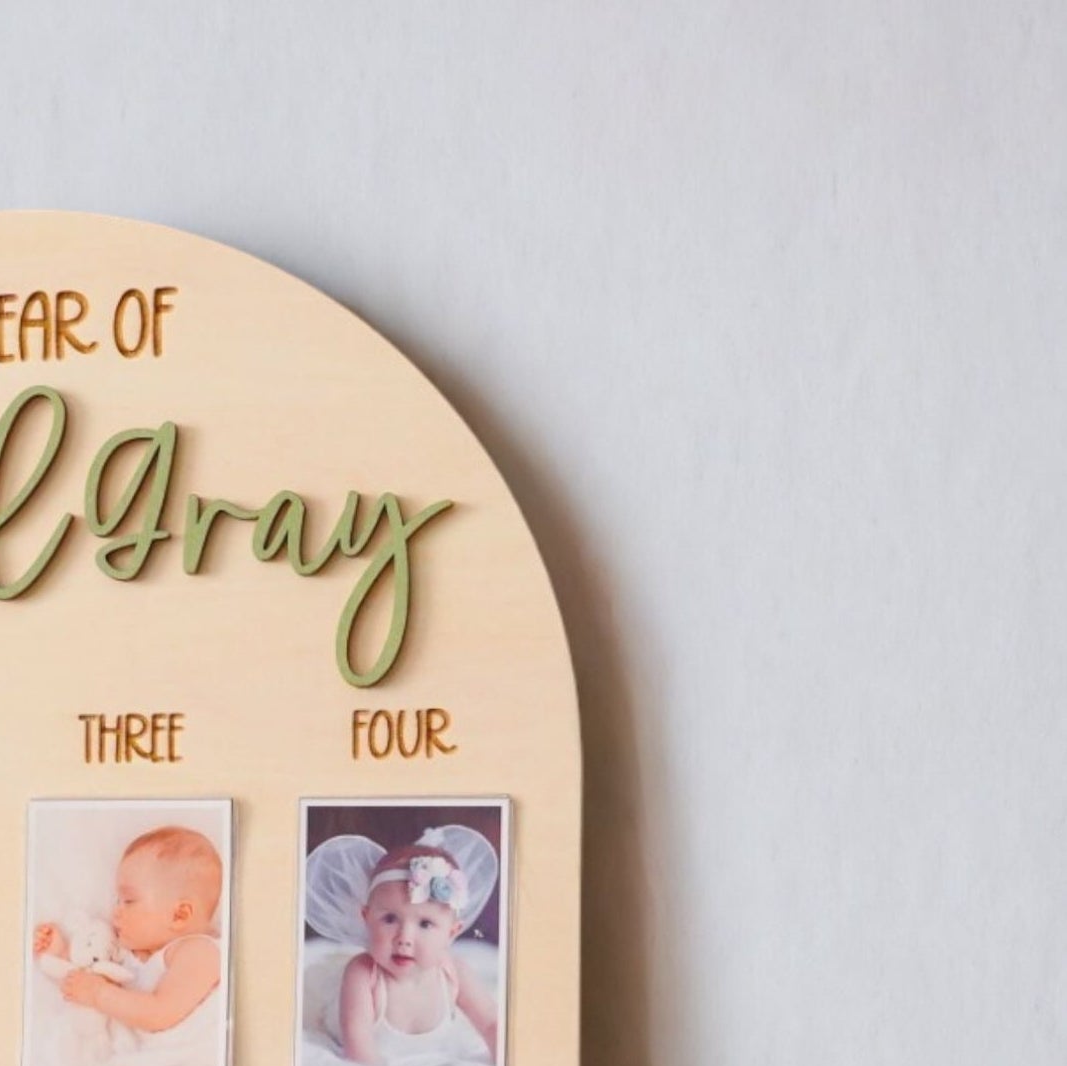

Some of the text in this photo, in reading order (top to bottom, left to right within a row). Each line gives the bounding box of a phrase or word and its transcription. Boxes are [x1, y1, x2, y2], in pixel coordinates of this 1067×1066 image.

[112, 285, 179, 359] OF
[84, 420, 454, 688] Gray
[77, 712, 185, 764] THREE
[351, 707, 458, 761] FOUR
